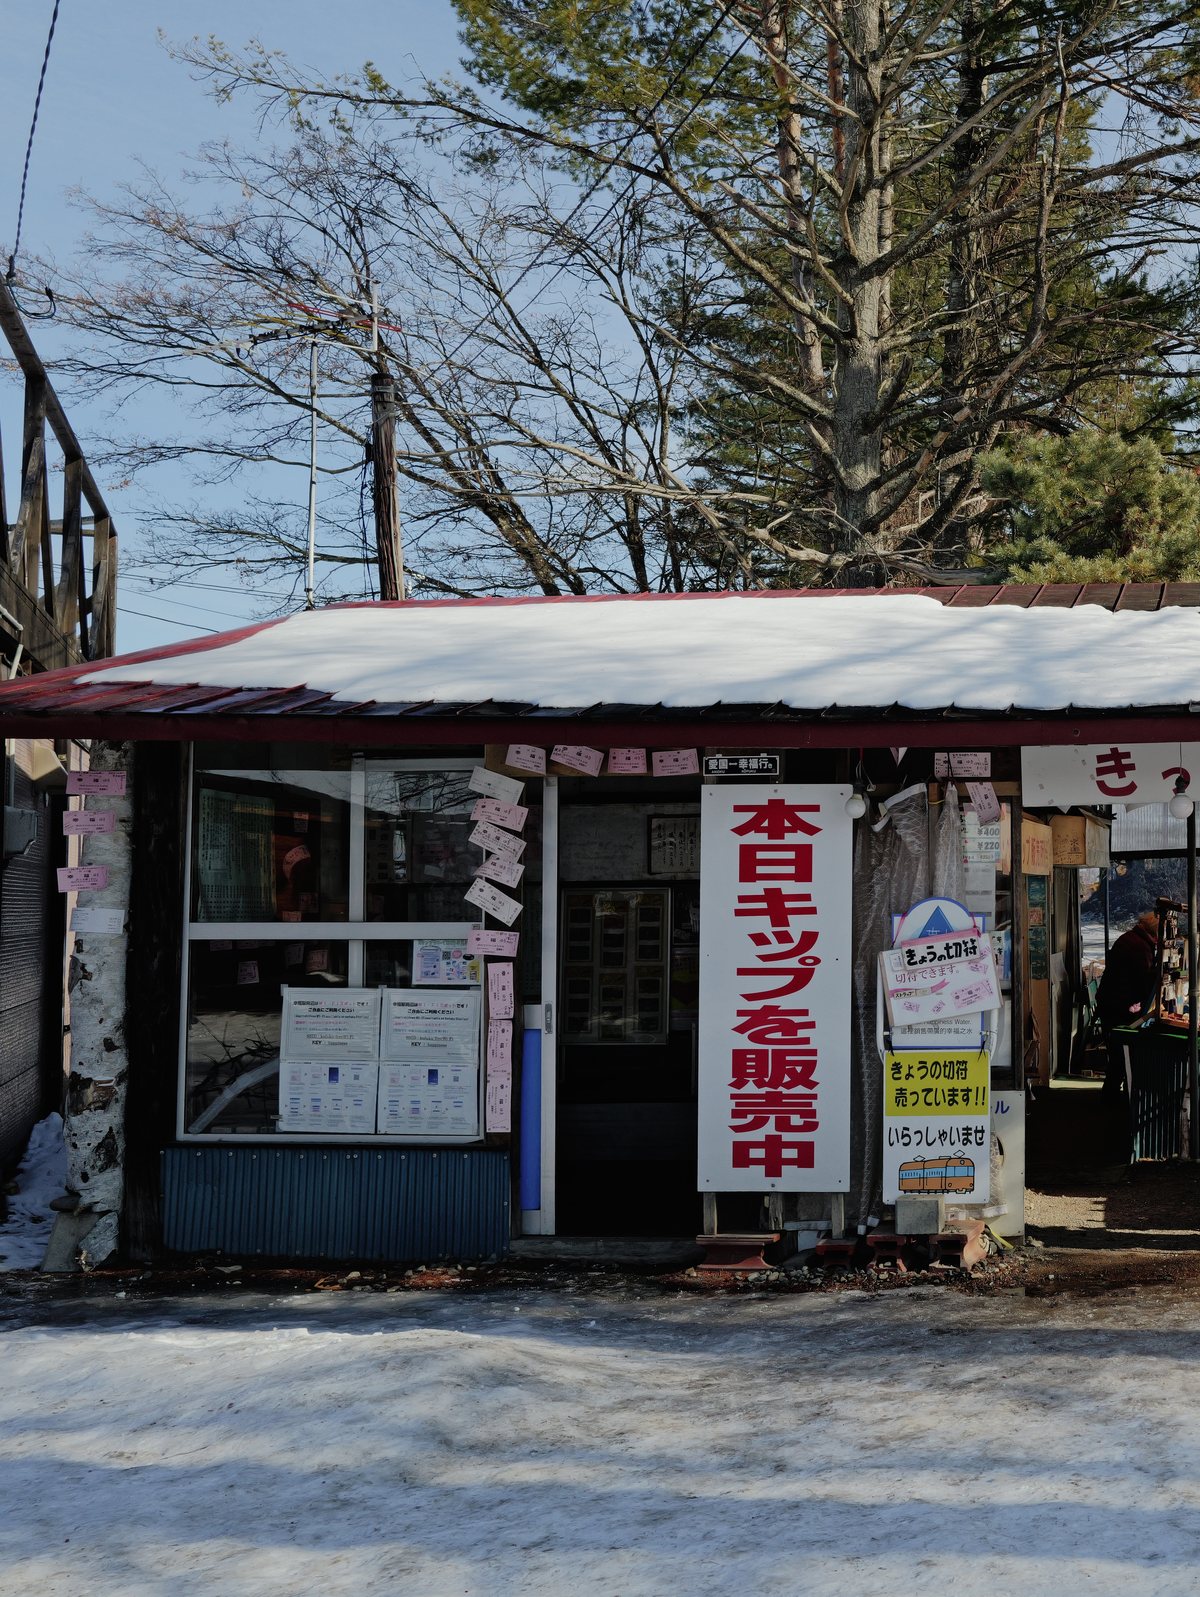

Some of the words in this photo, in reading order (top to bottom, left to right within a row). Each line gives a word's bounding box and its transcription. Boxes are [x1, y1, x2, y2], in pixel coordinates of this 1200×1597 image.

[905, 938, 978, 966] きょうの切符
[727, 798, 822, 1179] 本日キップを販売中
[891, 1060, 968, 1081] きょうの切符
[894, 1087, 987, 1107] 売っています!!
[888, 1125, 986, 1147] いらっしゃいませ
